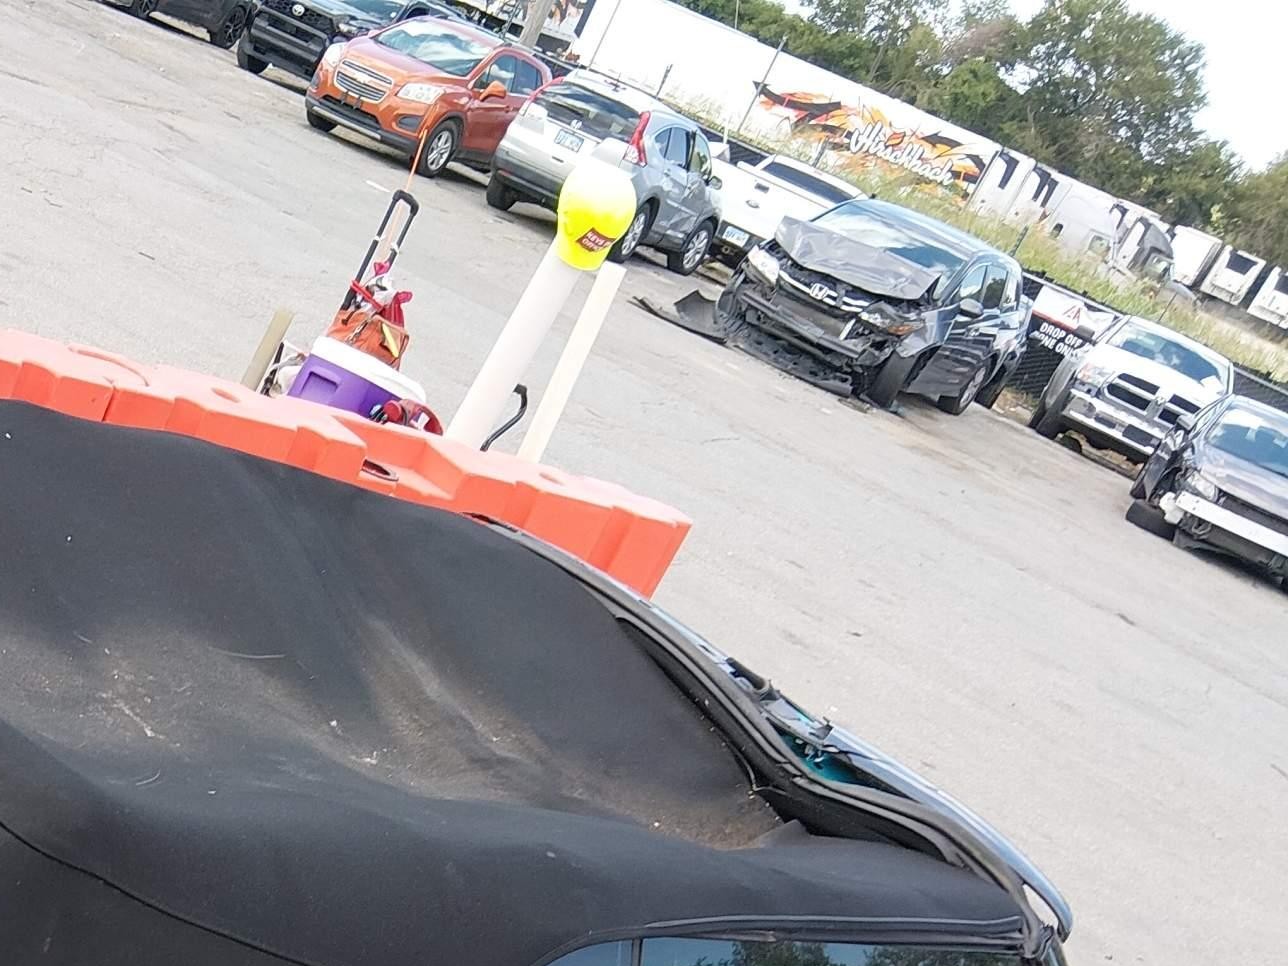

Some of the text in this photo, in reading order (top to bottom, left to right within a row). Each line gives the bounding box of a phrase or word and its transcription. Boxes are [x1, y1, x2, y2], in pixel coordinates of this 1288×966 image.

[849, 120, 954, 186] Hirschbach
[1039, 321, 1084, 348] DROP OFF
